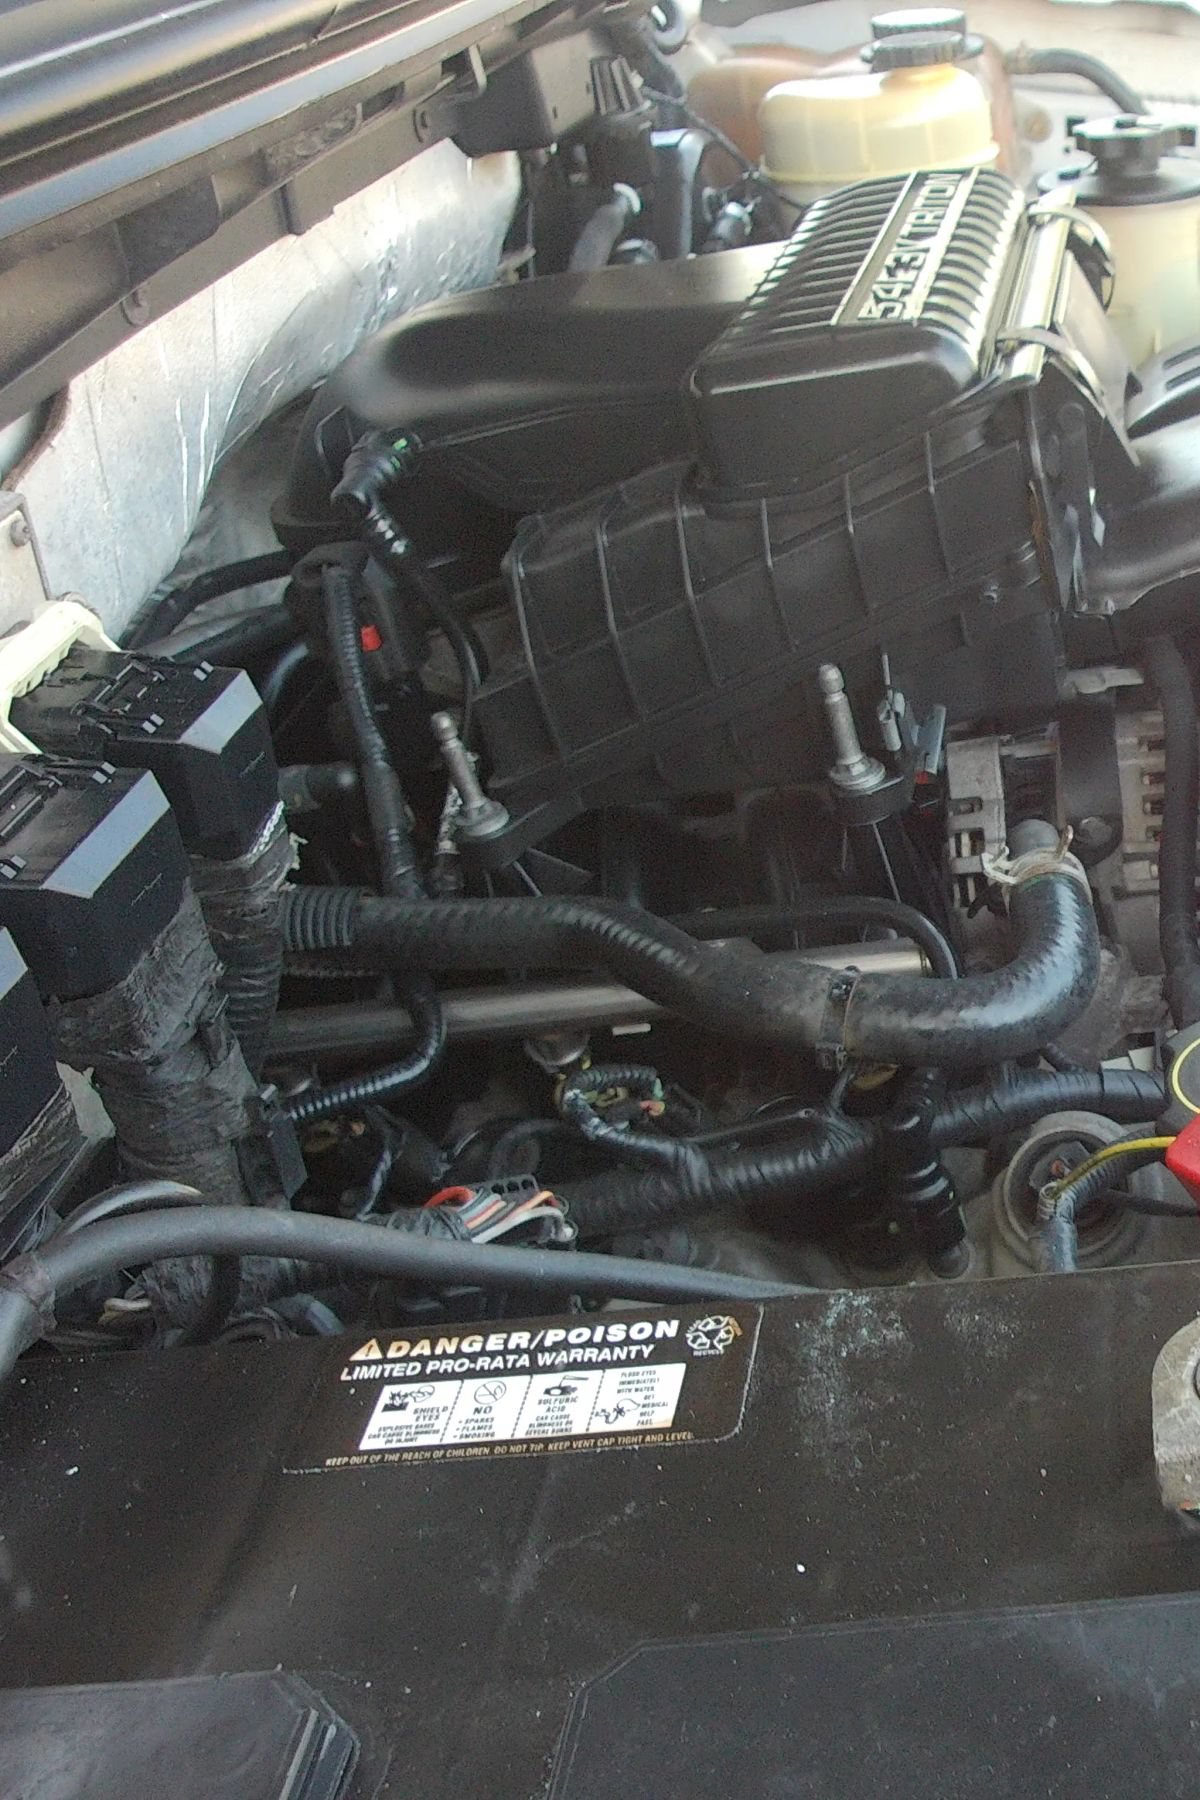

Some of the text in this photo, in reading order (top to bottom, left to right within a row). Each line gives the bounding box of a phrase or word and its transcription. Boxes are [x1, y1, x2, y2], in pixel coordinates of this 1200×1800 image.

[900, 173, 962, 238] TRITON
[386, 1319, 680, 1359] DANGER/POISON
[340, 1344, 655, 1381] LIMITED PRO-RATA WARRANTY
[473, 1406, 492, 1415] NO
[325, 1457, 349, 1466] KEEP
[350, 1455, 368, 1465] OUT
[383, 1453, 400, 1462] THE
[402, 1450, 431, 1460] REACH
[494, 1446, 507, 1454] DO
[509, 1444, 527, 1453] NOT
[547, 1441, 570, 1451] KEEP
[573, 1439, 595, 1449] VENT
[597, 1437, 615, 1447] CAP
[618, 1435, 643, 1445] TIGHT
[645, 1433, 664, 1442] AND
